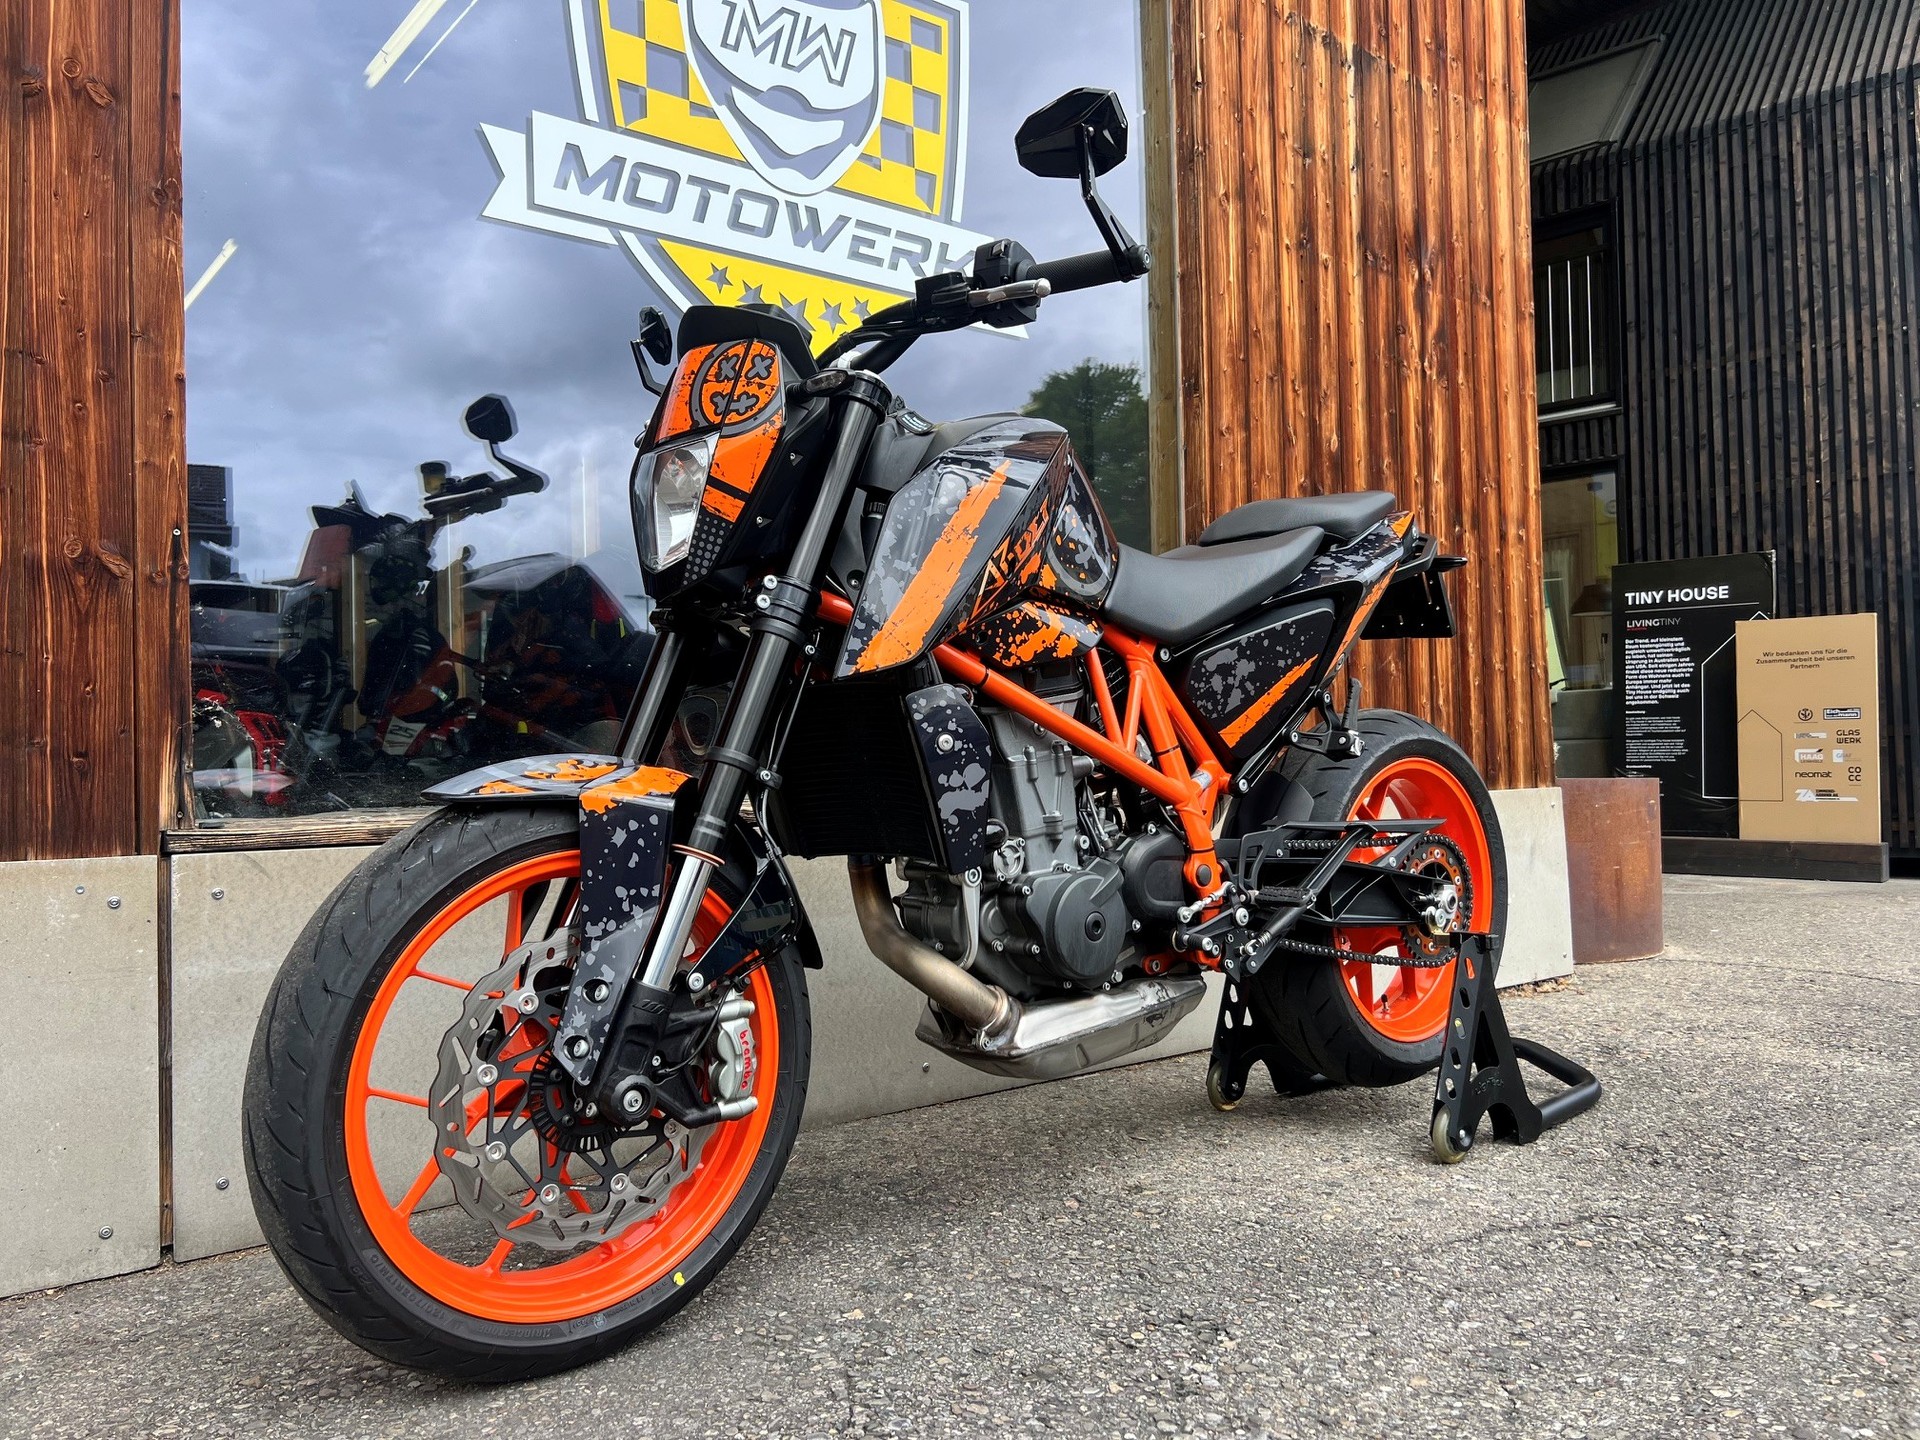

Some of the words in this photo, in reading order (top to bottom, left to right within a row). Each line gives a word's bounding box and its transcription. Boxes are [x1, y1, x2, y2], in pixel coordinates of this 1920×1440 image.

[1625, 590, 1663, 605] TINY
[1668, 586, 1729, 602] HOUSE
[1627, 618, 1681, 628] LIVINGTINY
[739, 1029, 753, 1090] brembo
